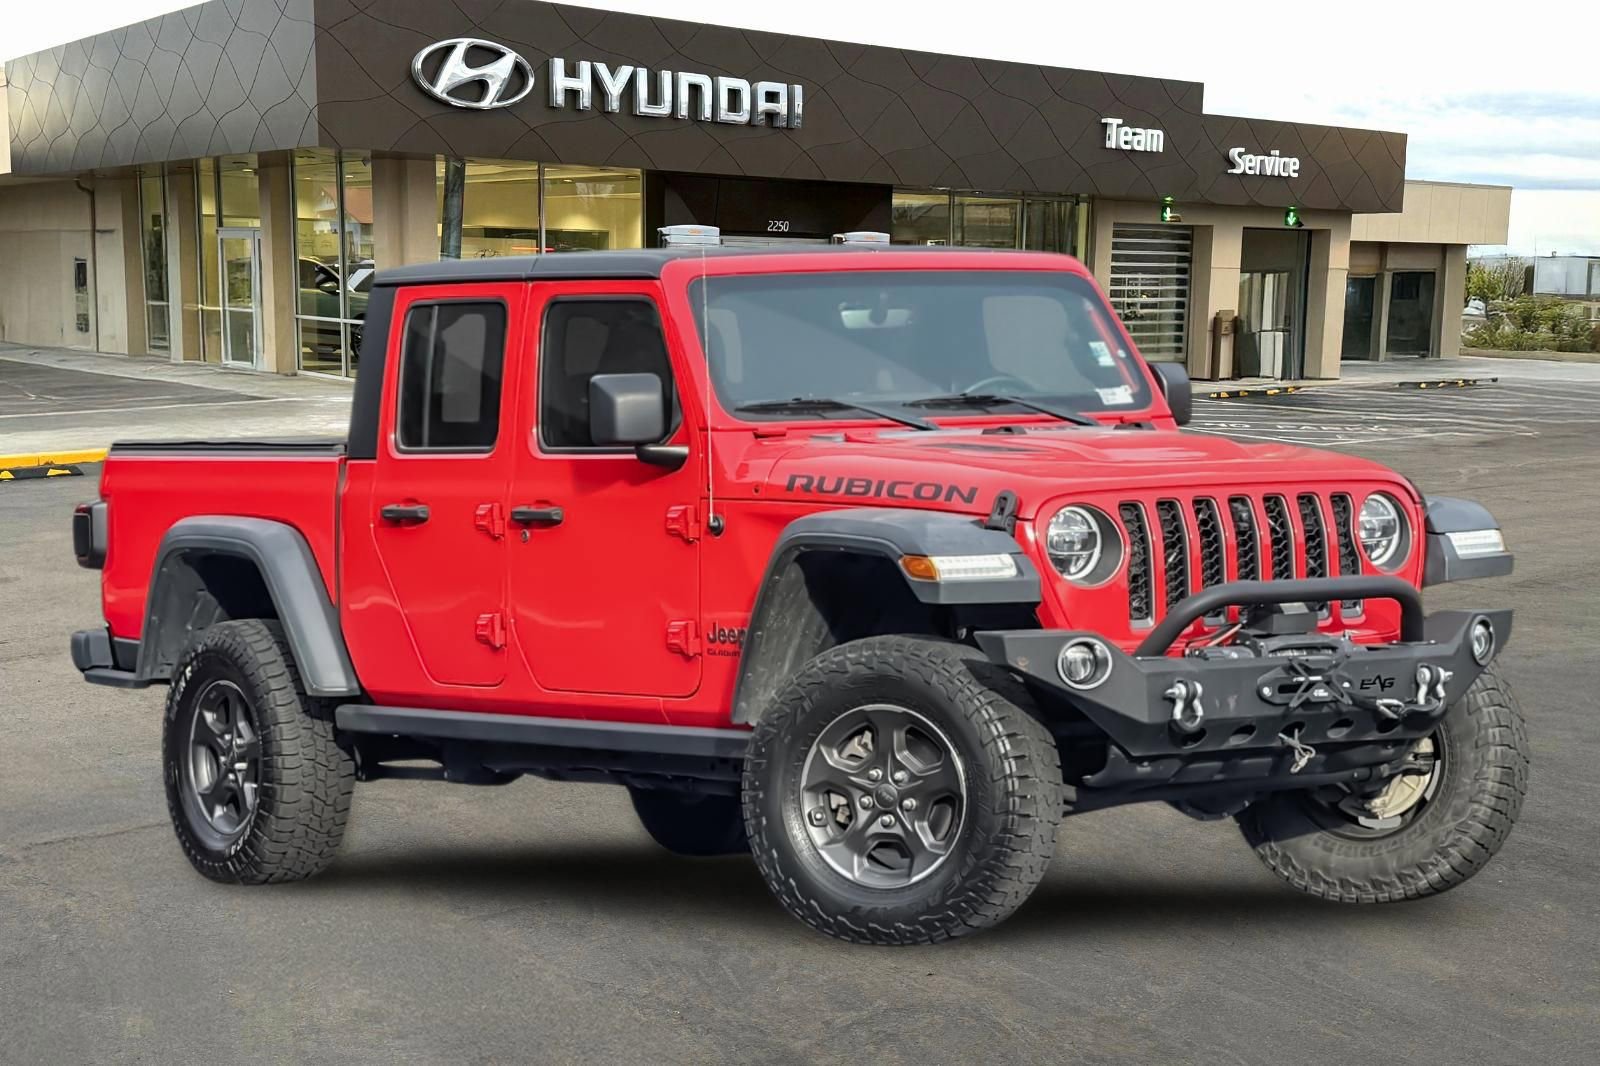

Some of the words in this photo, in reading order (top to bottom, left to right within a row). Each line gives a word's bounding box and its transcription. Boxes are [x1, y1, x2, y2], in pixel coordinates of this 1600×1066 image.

[549, 57, 803, 128] HYUNDAI
[1101, 117, 1164, 153] Team
[1227, 147, 1300, 178] Service
[767, 220, 790, 232] 2250
[785, 473, 979, 504] RUBICON
